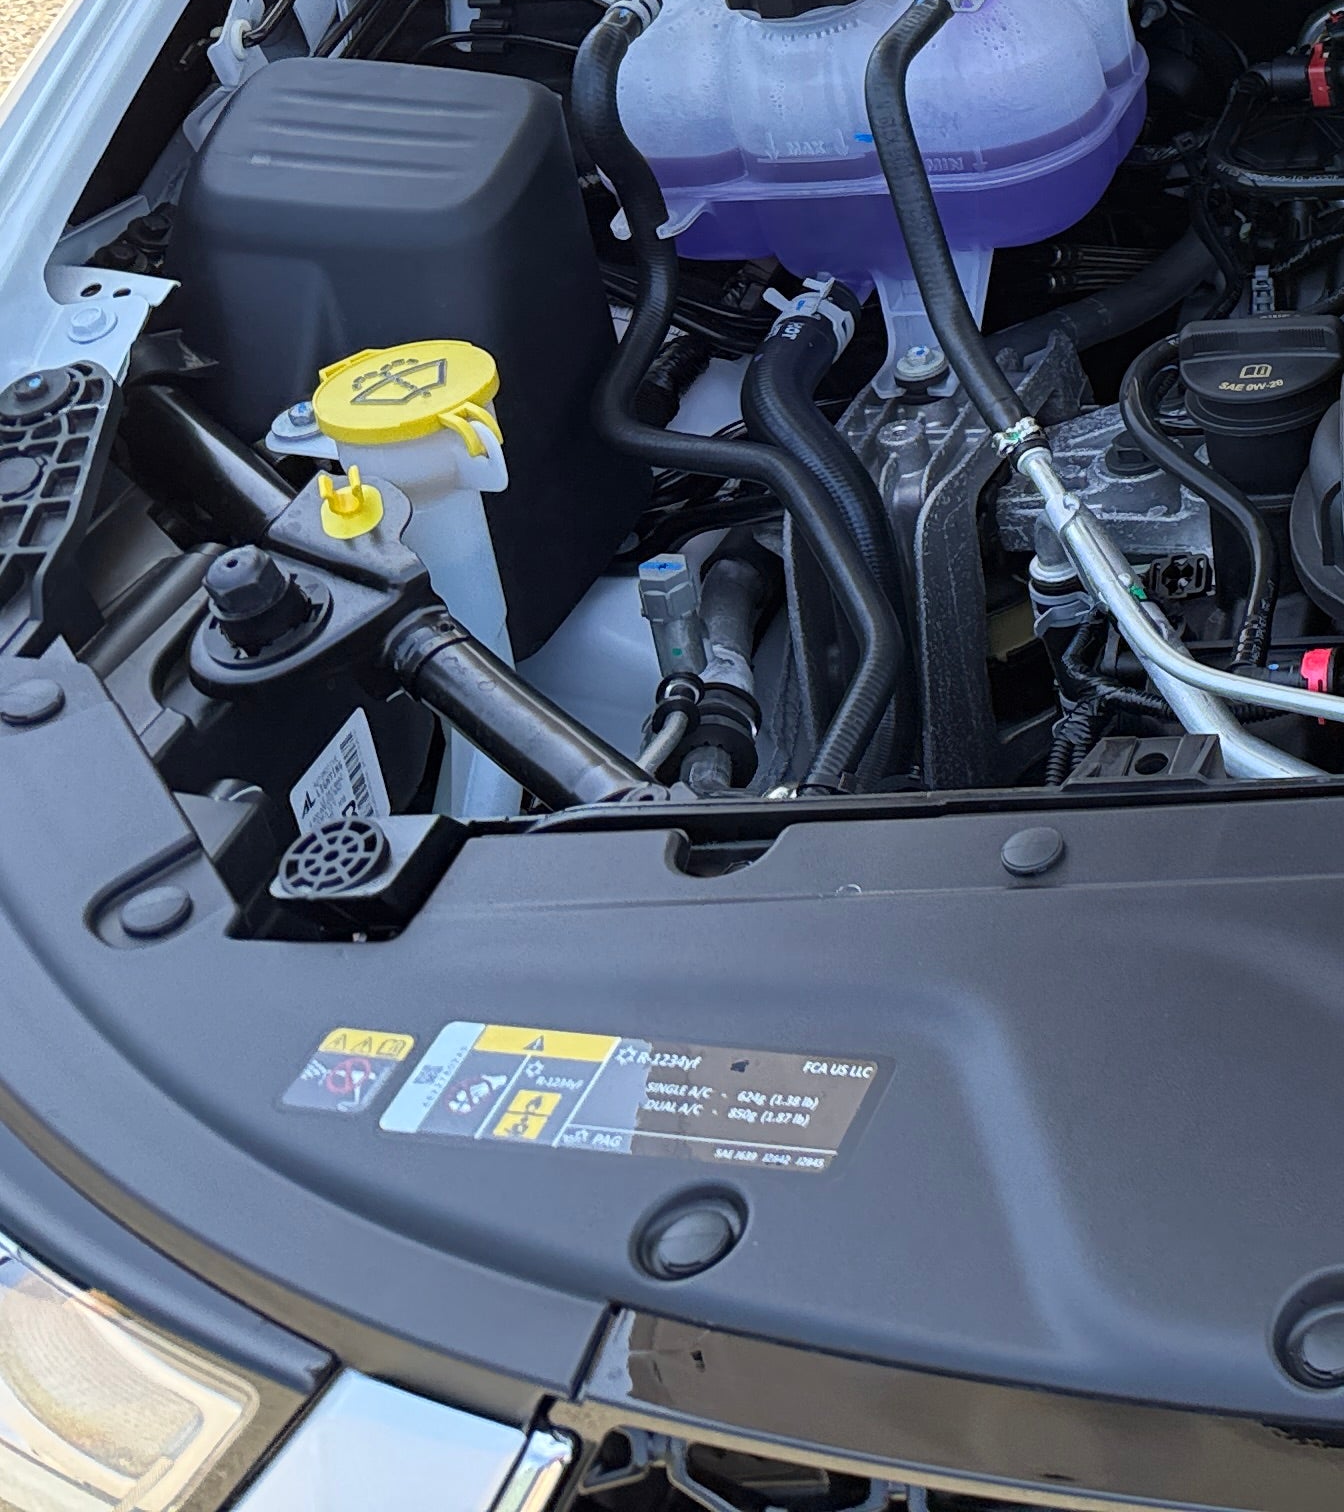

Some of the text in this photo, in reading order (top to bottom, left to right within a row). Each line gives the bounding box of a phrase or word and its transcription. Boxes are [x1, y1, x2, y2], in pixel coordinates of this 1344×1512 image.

[786, 141, 826, 156] MAX
[925, 157, 964, 171] MIN
[1219, 379, 1284, 392] SAE 0W-20
[636, 1051, 874, 1079] R-1234yf FCA US LLC
[646, 1081, 688, 1097] SINGLE
[688, 1085, 713, 1099] A/C
[737, 1090, 767, 1107] 624g
[643, 1100, 678, 1113] DUAL
[677, 1103, 704, 1116] A/C
[727, 1107, 759, 1124] 850g
[592, 1134, 623, 1148] PAG
